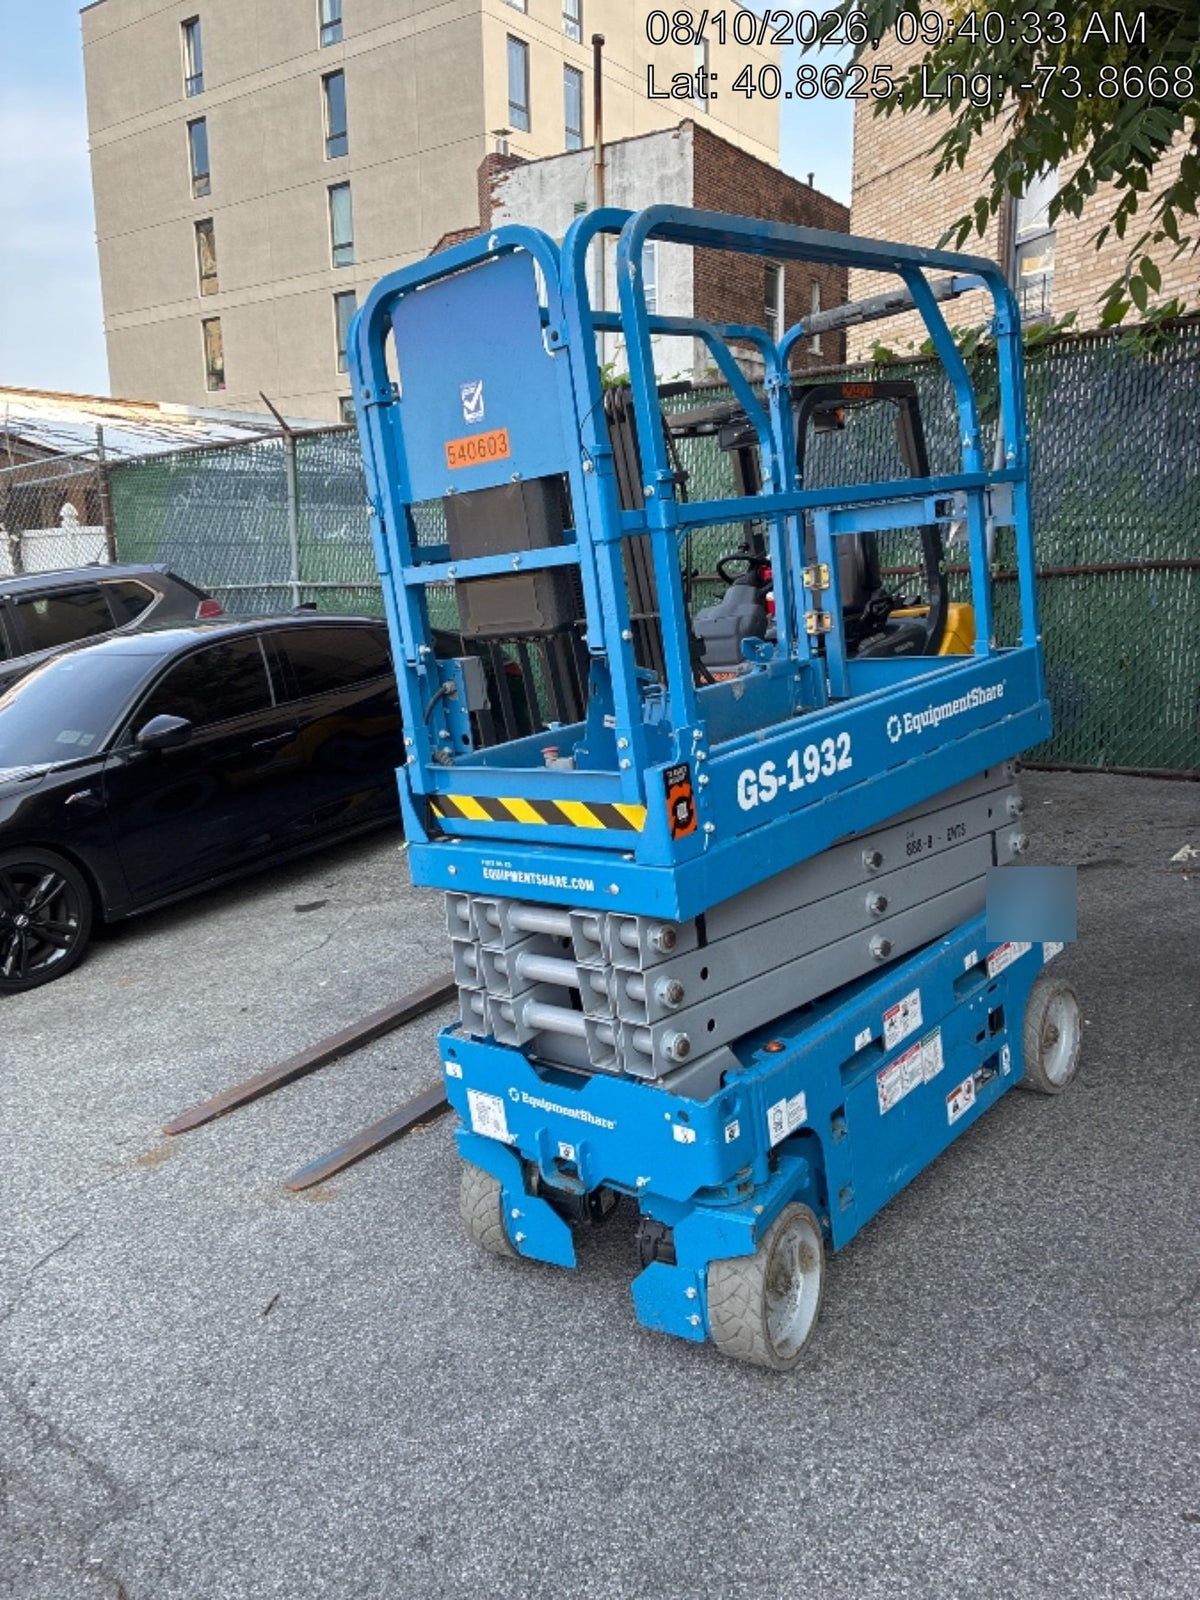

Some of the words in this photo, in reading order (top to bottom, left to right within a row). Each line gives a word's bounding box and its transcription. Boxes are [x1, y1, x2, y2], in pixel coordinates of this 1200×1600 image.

[446, 432, 508, 465] 540603
[904, 682, 1005, 735] EquipmentShare
[736, 731, 853, 812] GS-1932
[482, 867, 595, 892] EQUIPMENTSHARE.COM
